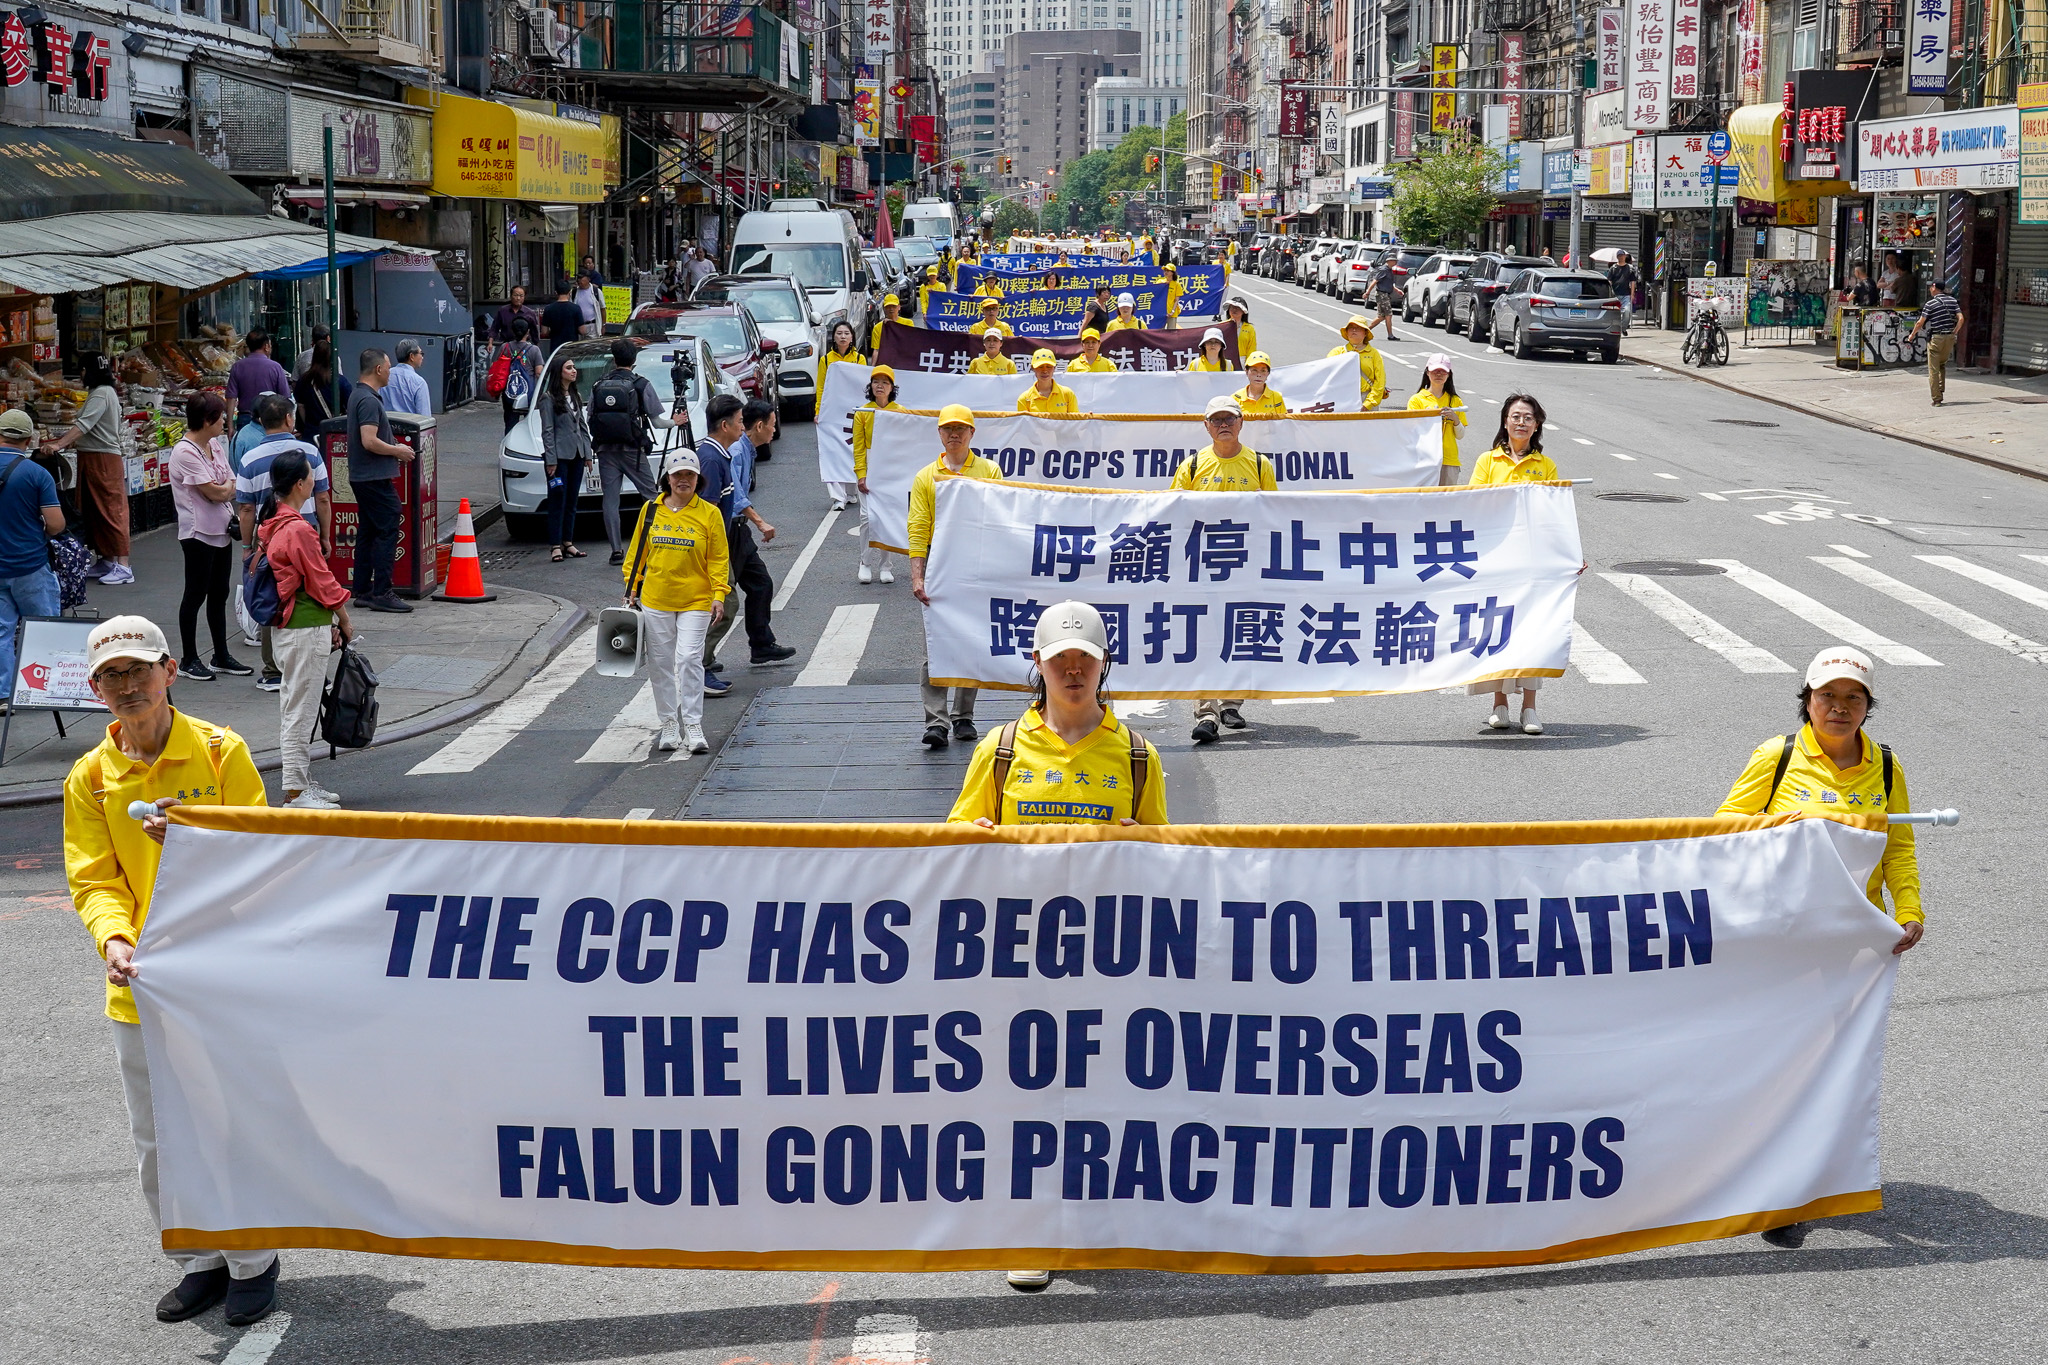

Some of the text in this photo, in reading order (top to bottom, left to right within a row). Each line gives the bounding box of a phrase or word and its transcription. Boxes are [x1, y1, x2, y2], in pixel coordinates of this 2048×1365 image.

[1672, 0, 1699, 96] 丰商場
[1324, 105, 1338, 152] 大帝國
[1951, 127, 1991, 151] PHARMACY
[1993, 125, 2006, 149] INC
[458, 157, 515, 170] 福州小吃店
[460, 171, 514, 181] 646-326-8810
[939, 321, 972, 333] Releas
[1019, 321, 1049, 334] Gong
[1043, 449, 1125, 479] CCP'S
[1031, 519, 1479, 585] 呼籲停止中共
[1061, 615, 1084, 629] alo
[57, 661, 78, 669] Open
[1017, 769, 1119, 790] 法輪大法
[1794, 788, 1883, 807] 法輪大法
[1020, 803, 1108, 818] FALUN DAFA
[386, 889, 1713, 984] THE CCP HAS BEGUN TO THREATEN
[589, 1008, 1523, 1097] THE LIVES OF OVERSEAS
[497, 1117, 1625, 1209] FALUN GONG PRACTITIONERS
